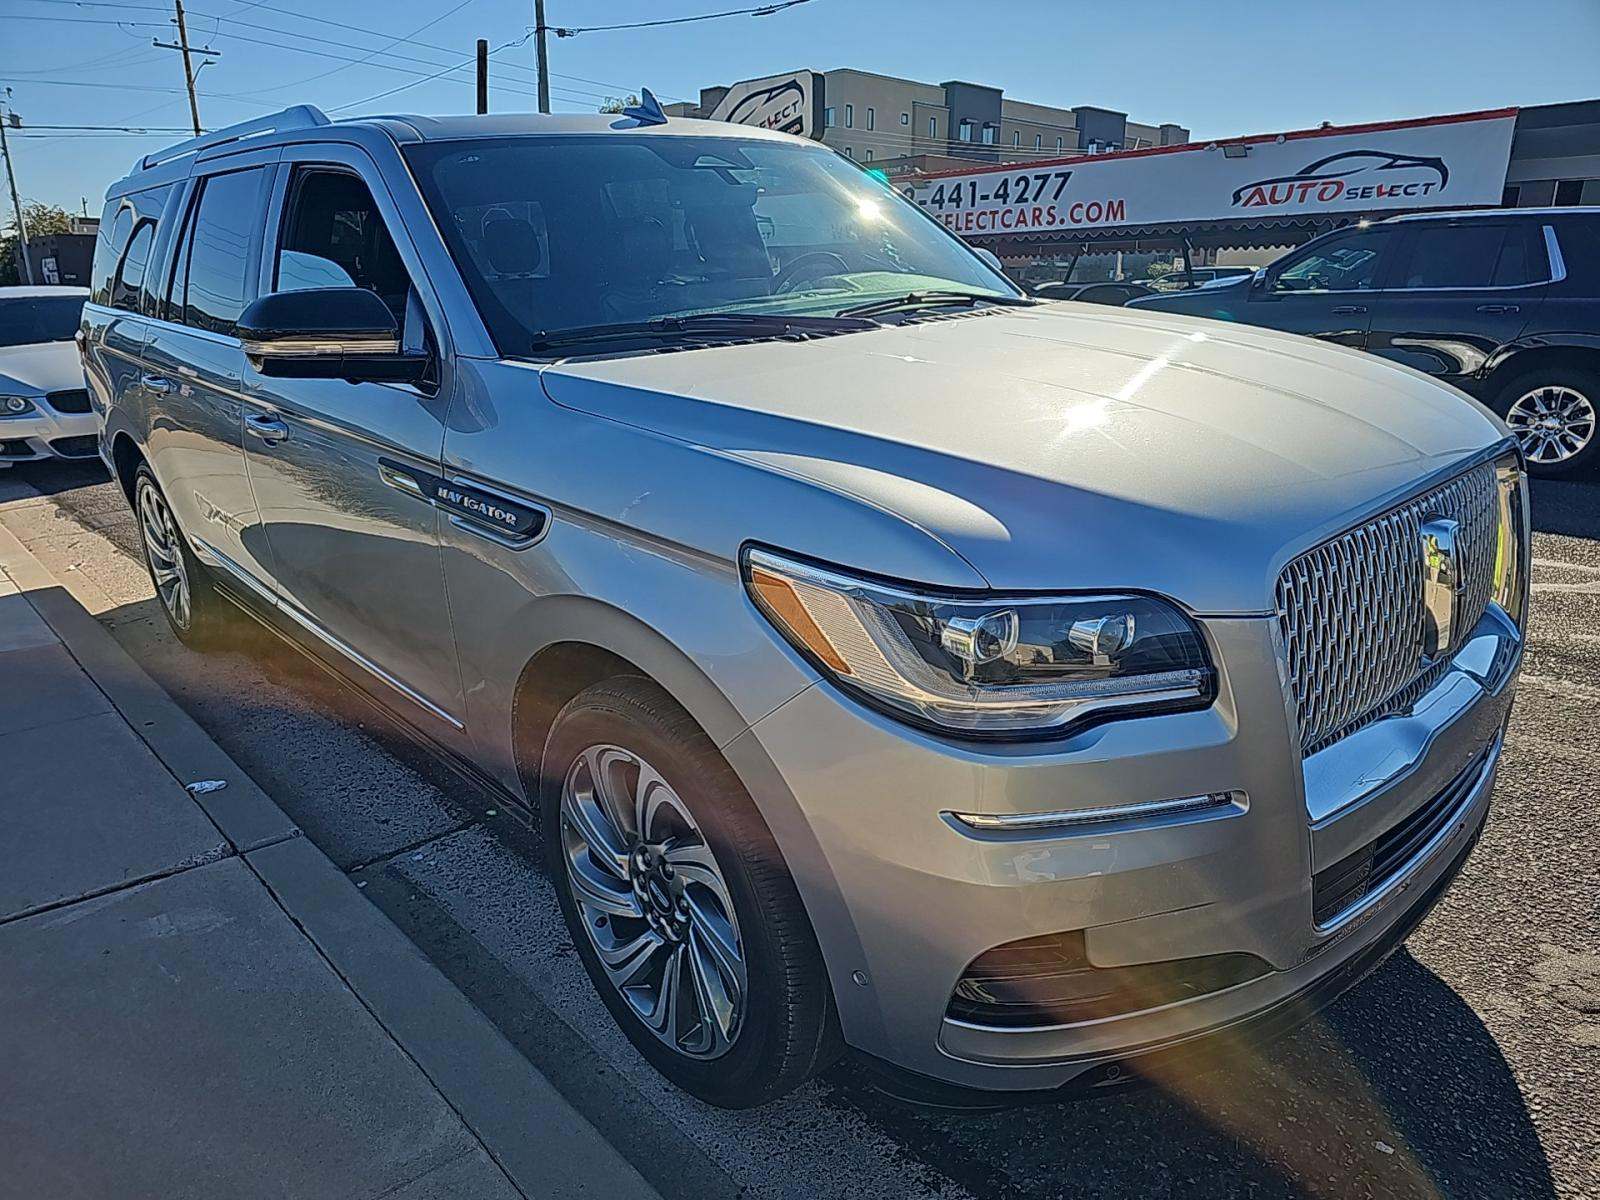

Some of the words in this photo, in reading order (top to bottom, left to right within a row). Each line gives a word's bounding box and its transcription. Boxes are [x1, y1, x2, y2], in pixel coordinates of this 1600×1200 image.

[756, 100, 799, 128] ELECT
[1241, 180, 1345, 207] AUTO
[1345, 182, 1438, 200] SELECT
[437, 487, 518, 527] NAVIGATOR
